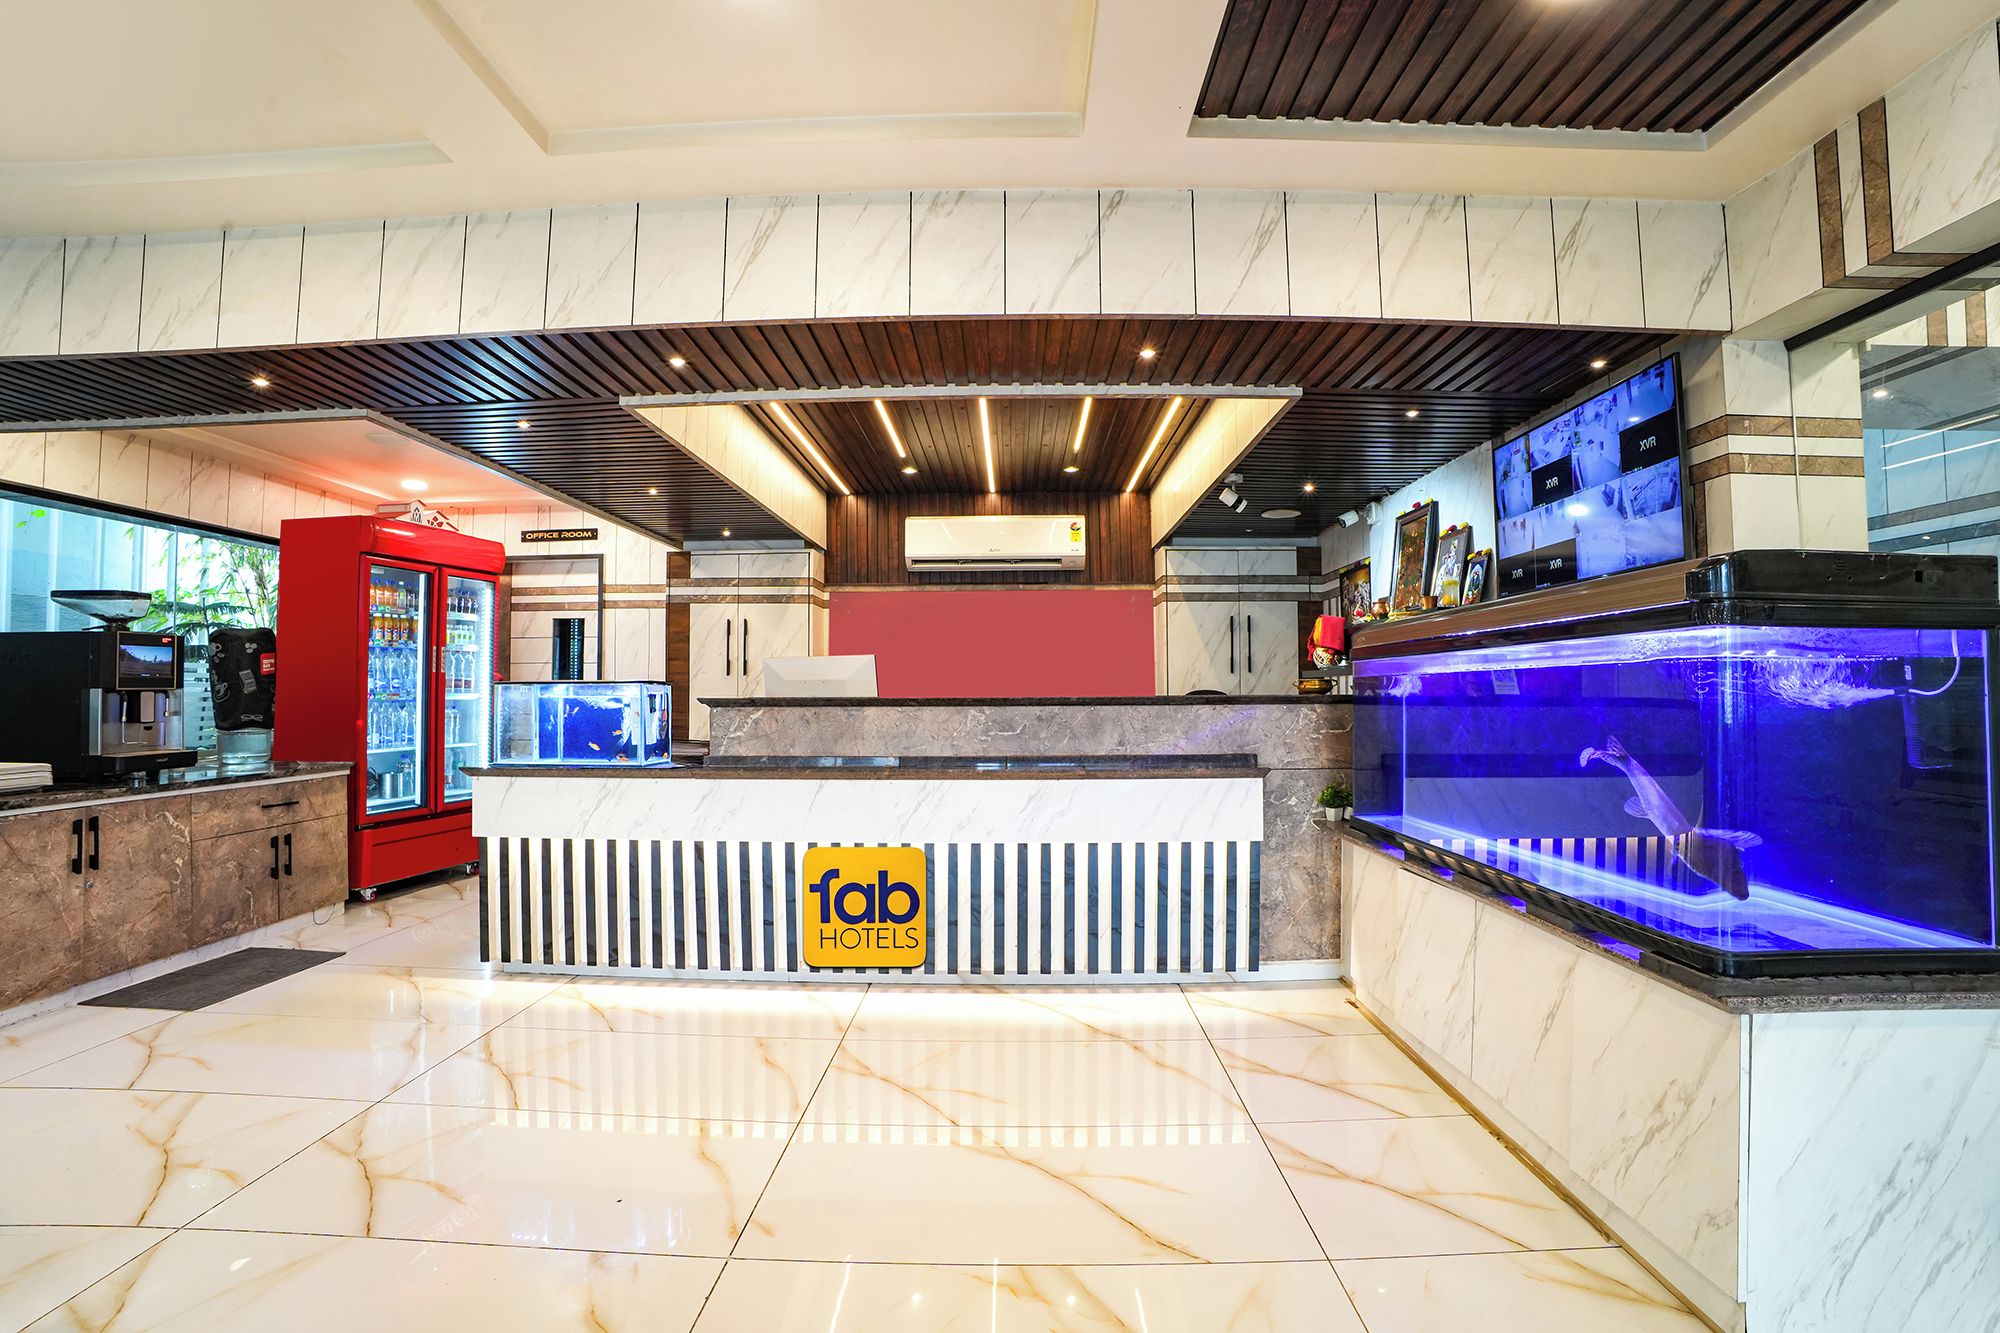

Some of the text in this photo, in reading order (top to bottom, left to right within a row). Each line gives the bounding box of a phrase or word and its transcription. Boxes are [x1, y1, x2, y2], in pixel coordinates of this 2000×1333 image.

[1639, 435, 1656, 451] XVR
[1545, 476, 1559, 490] XVR
[1549, 558, 1563, 571] XVR
[1511, 568, 1524, 580] XVR
[809, 868, 920, 925] fab
[820, 928, 919, 949] HOTELS
